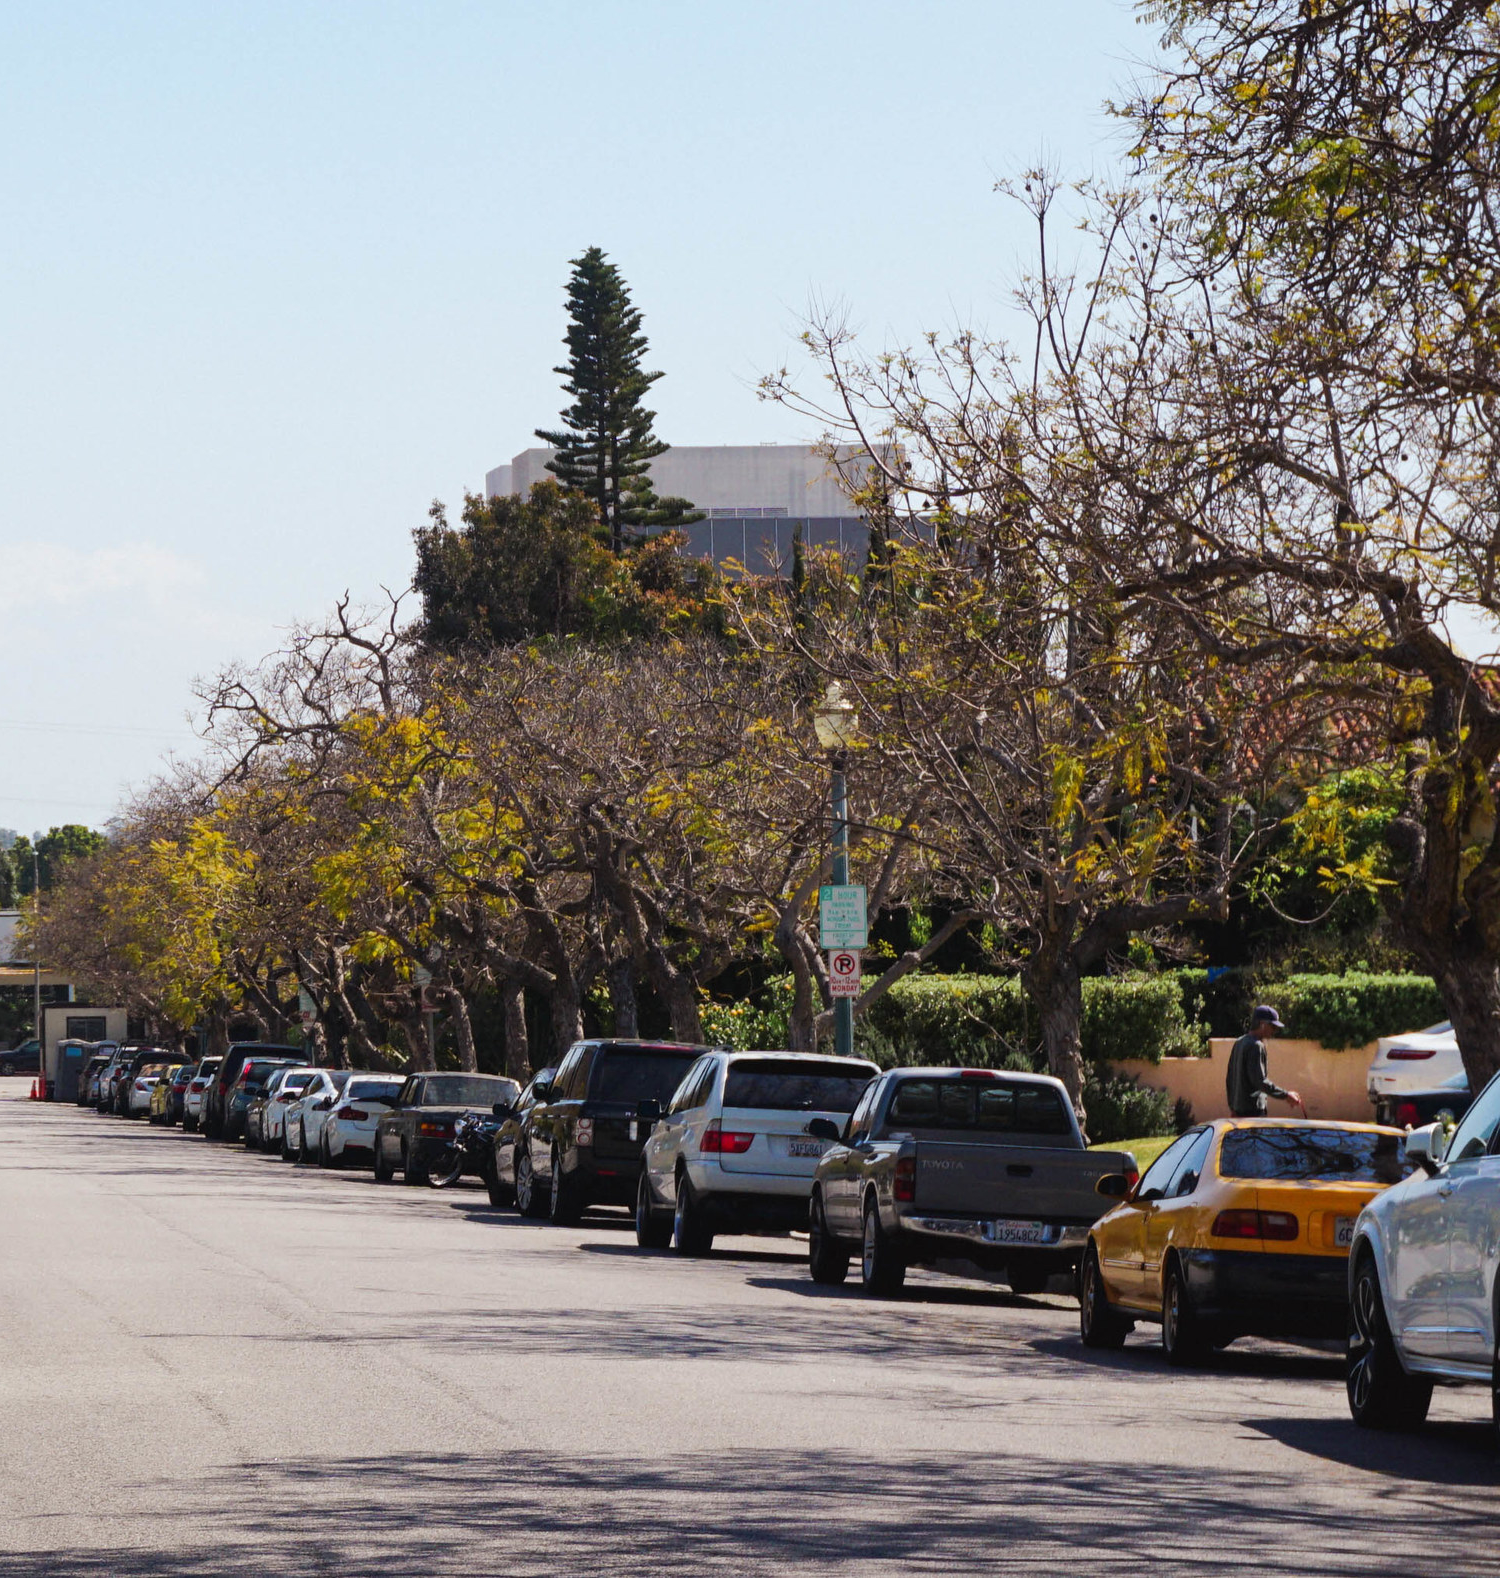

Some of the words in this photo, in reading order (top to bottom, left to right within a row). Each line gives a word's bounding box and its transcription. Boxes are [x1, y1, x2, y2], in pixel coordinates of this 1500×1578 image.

[823, 888, 831, 900] 2
[838, 891, 858, 899] HOUR
[921, 1159, 965, 1169] TOYOTA
